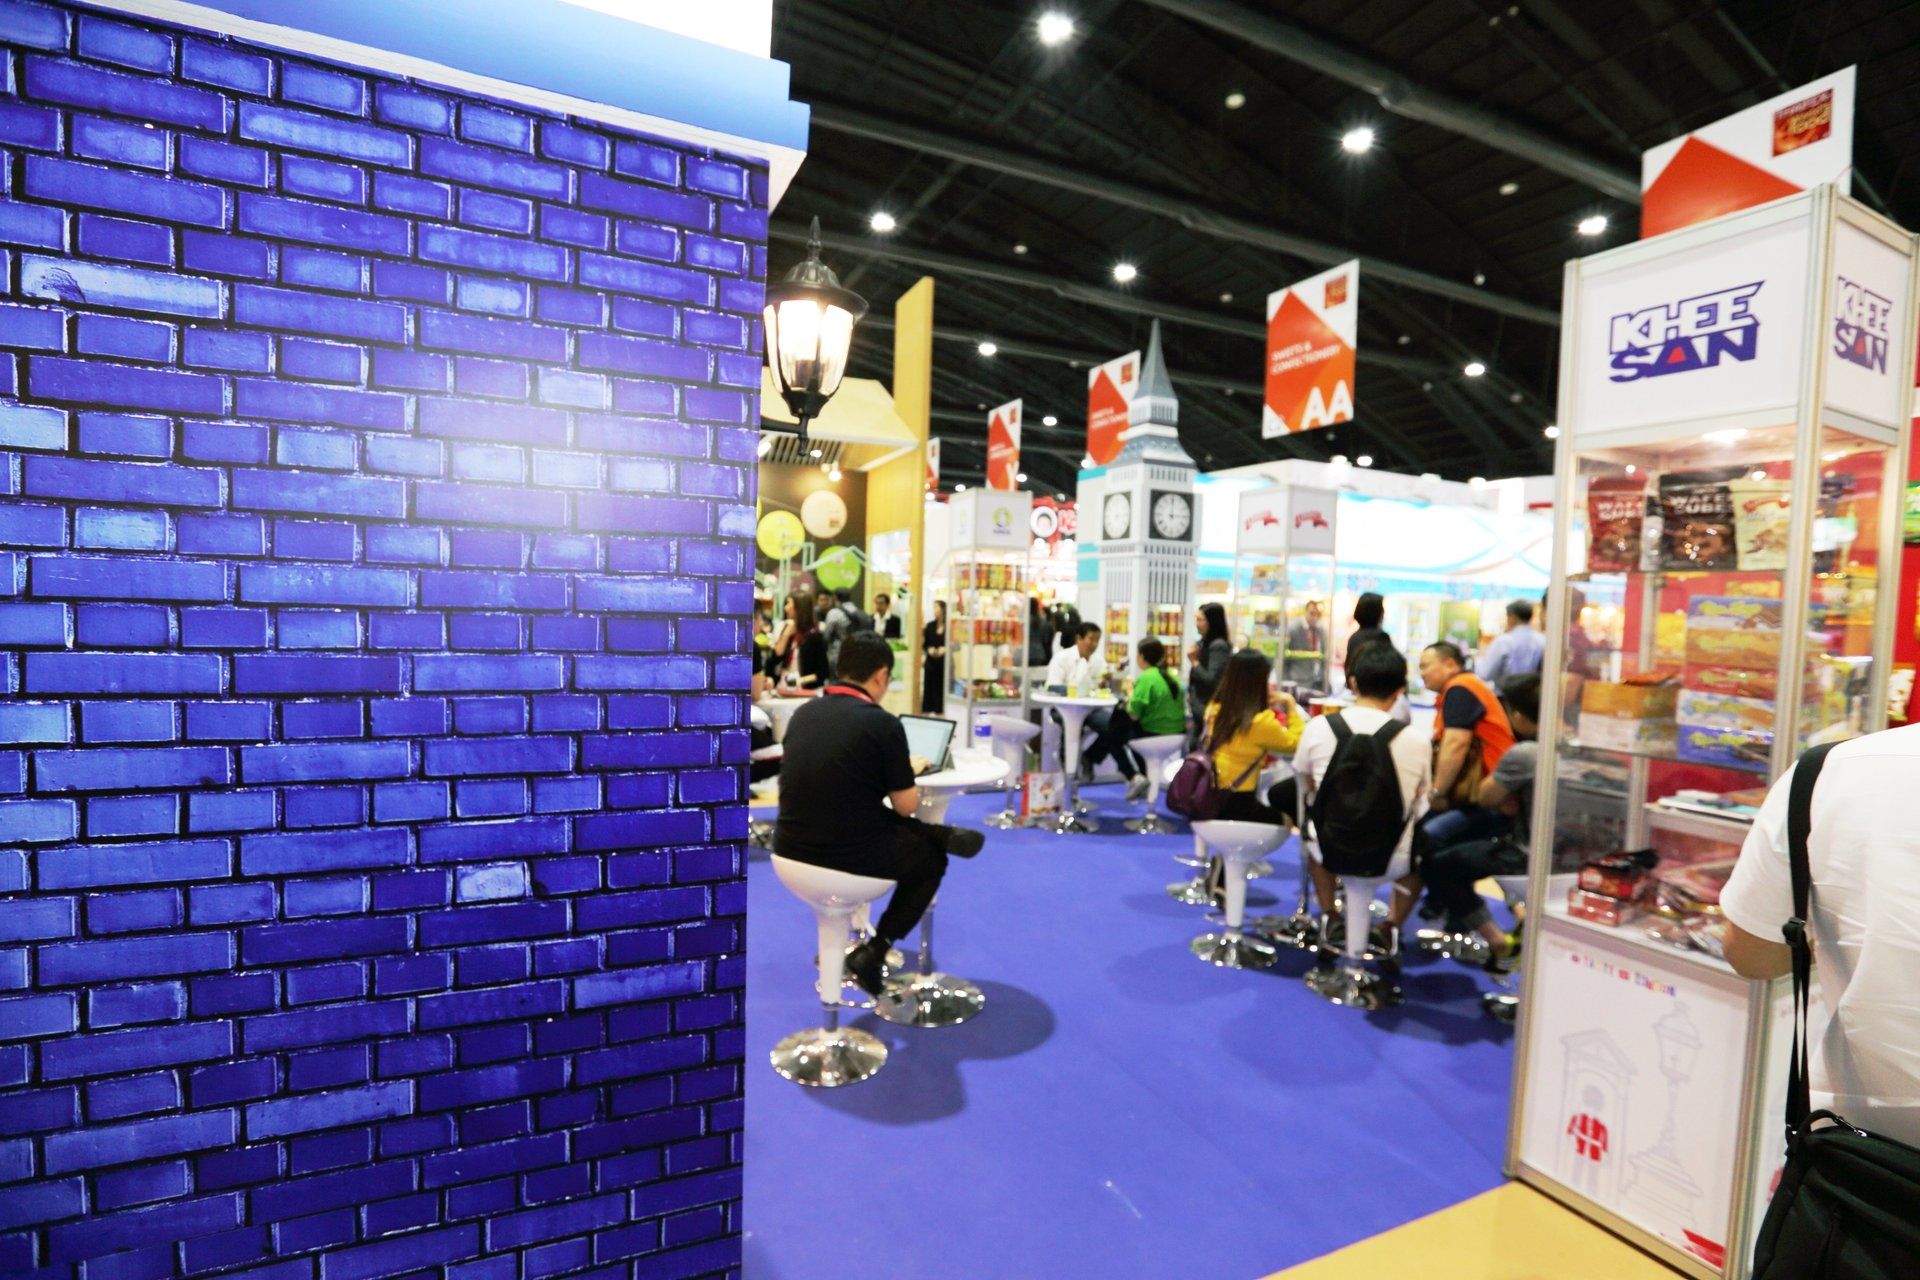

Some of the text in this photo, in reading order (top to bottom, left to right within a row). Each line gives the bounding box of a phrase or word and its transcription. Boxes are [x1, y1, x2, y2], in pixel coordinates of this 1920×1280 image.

[1609, 280, 1765, 355] KHEE
[1835, 275, 1893, 341] KHEE
[1609, 323, 1759, 383] SAN
[1833, 320, 1888, 375] SAN
[1299, 379, 1354, 431] AA
